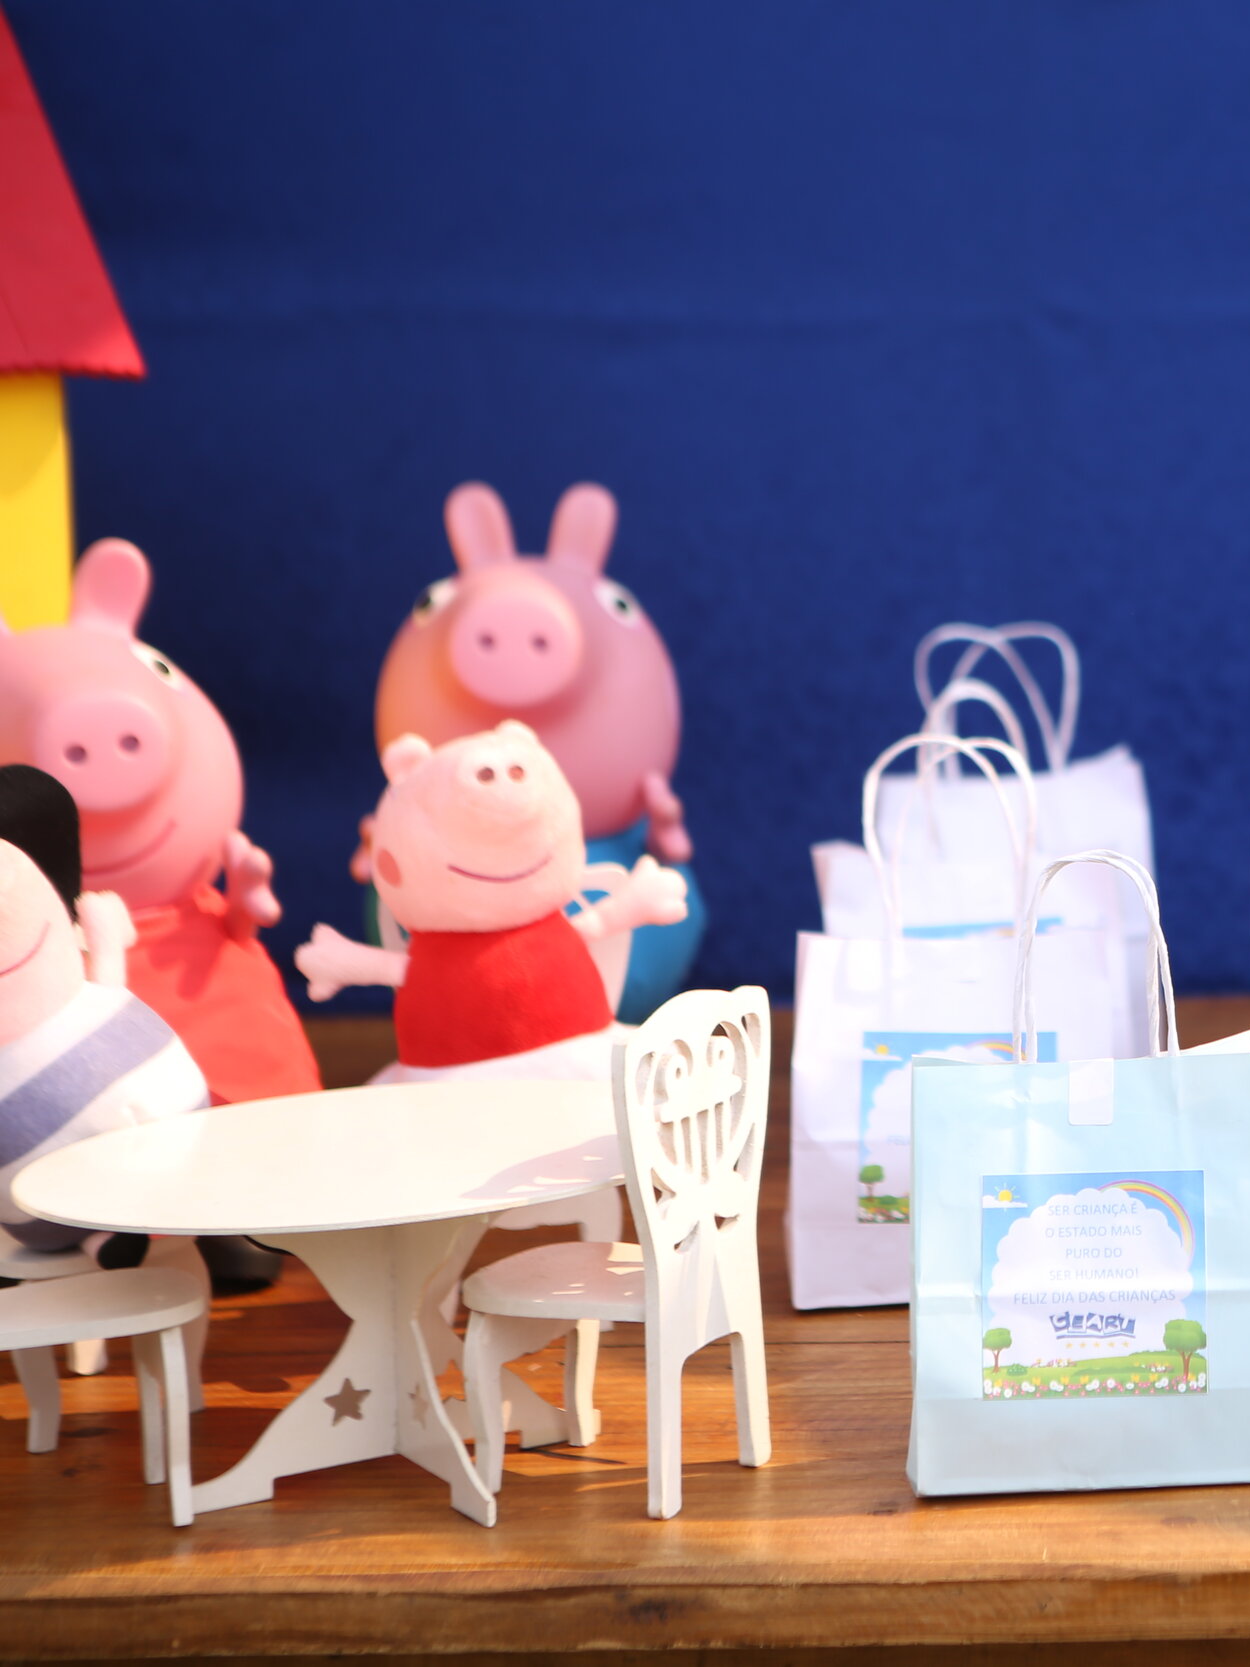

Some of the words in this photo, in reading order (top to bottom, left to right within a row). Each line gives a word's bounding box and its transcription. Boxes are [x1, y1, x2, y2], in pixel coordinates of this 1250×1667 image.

[1047, 1205, 1070, 1216] SER
[1073, 1204, 1127, 1218] CRIANÇA
[1131, 1202, 1138, 1215] É
[1045, 1227, 1055, 1238] O
[1058, 1226, 1107, 1238] ESTADO
[1110, 1225, 1142, 1236] MAIS
[1066, 1248, 1101, 1259] PURO
[1104, 1247, 1122, 1258] DO
[1049, 1270, 1071, 1281] SER
[1075, 1268, 1139, 1280] HUMANO!
[1013, 1293, 1047, 1305] FELIZ
[1052, 1292, 1075, 1304] DIA
[1078, 1291, 1106, 1303] DAS
[1109, 1289, 1176, 1304] CRIANÇAS
